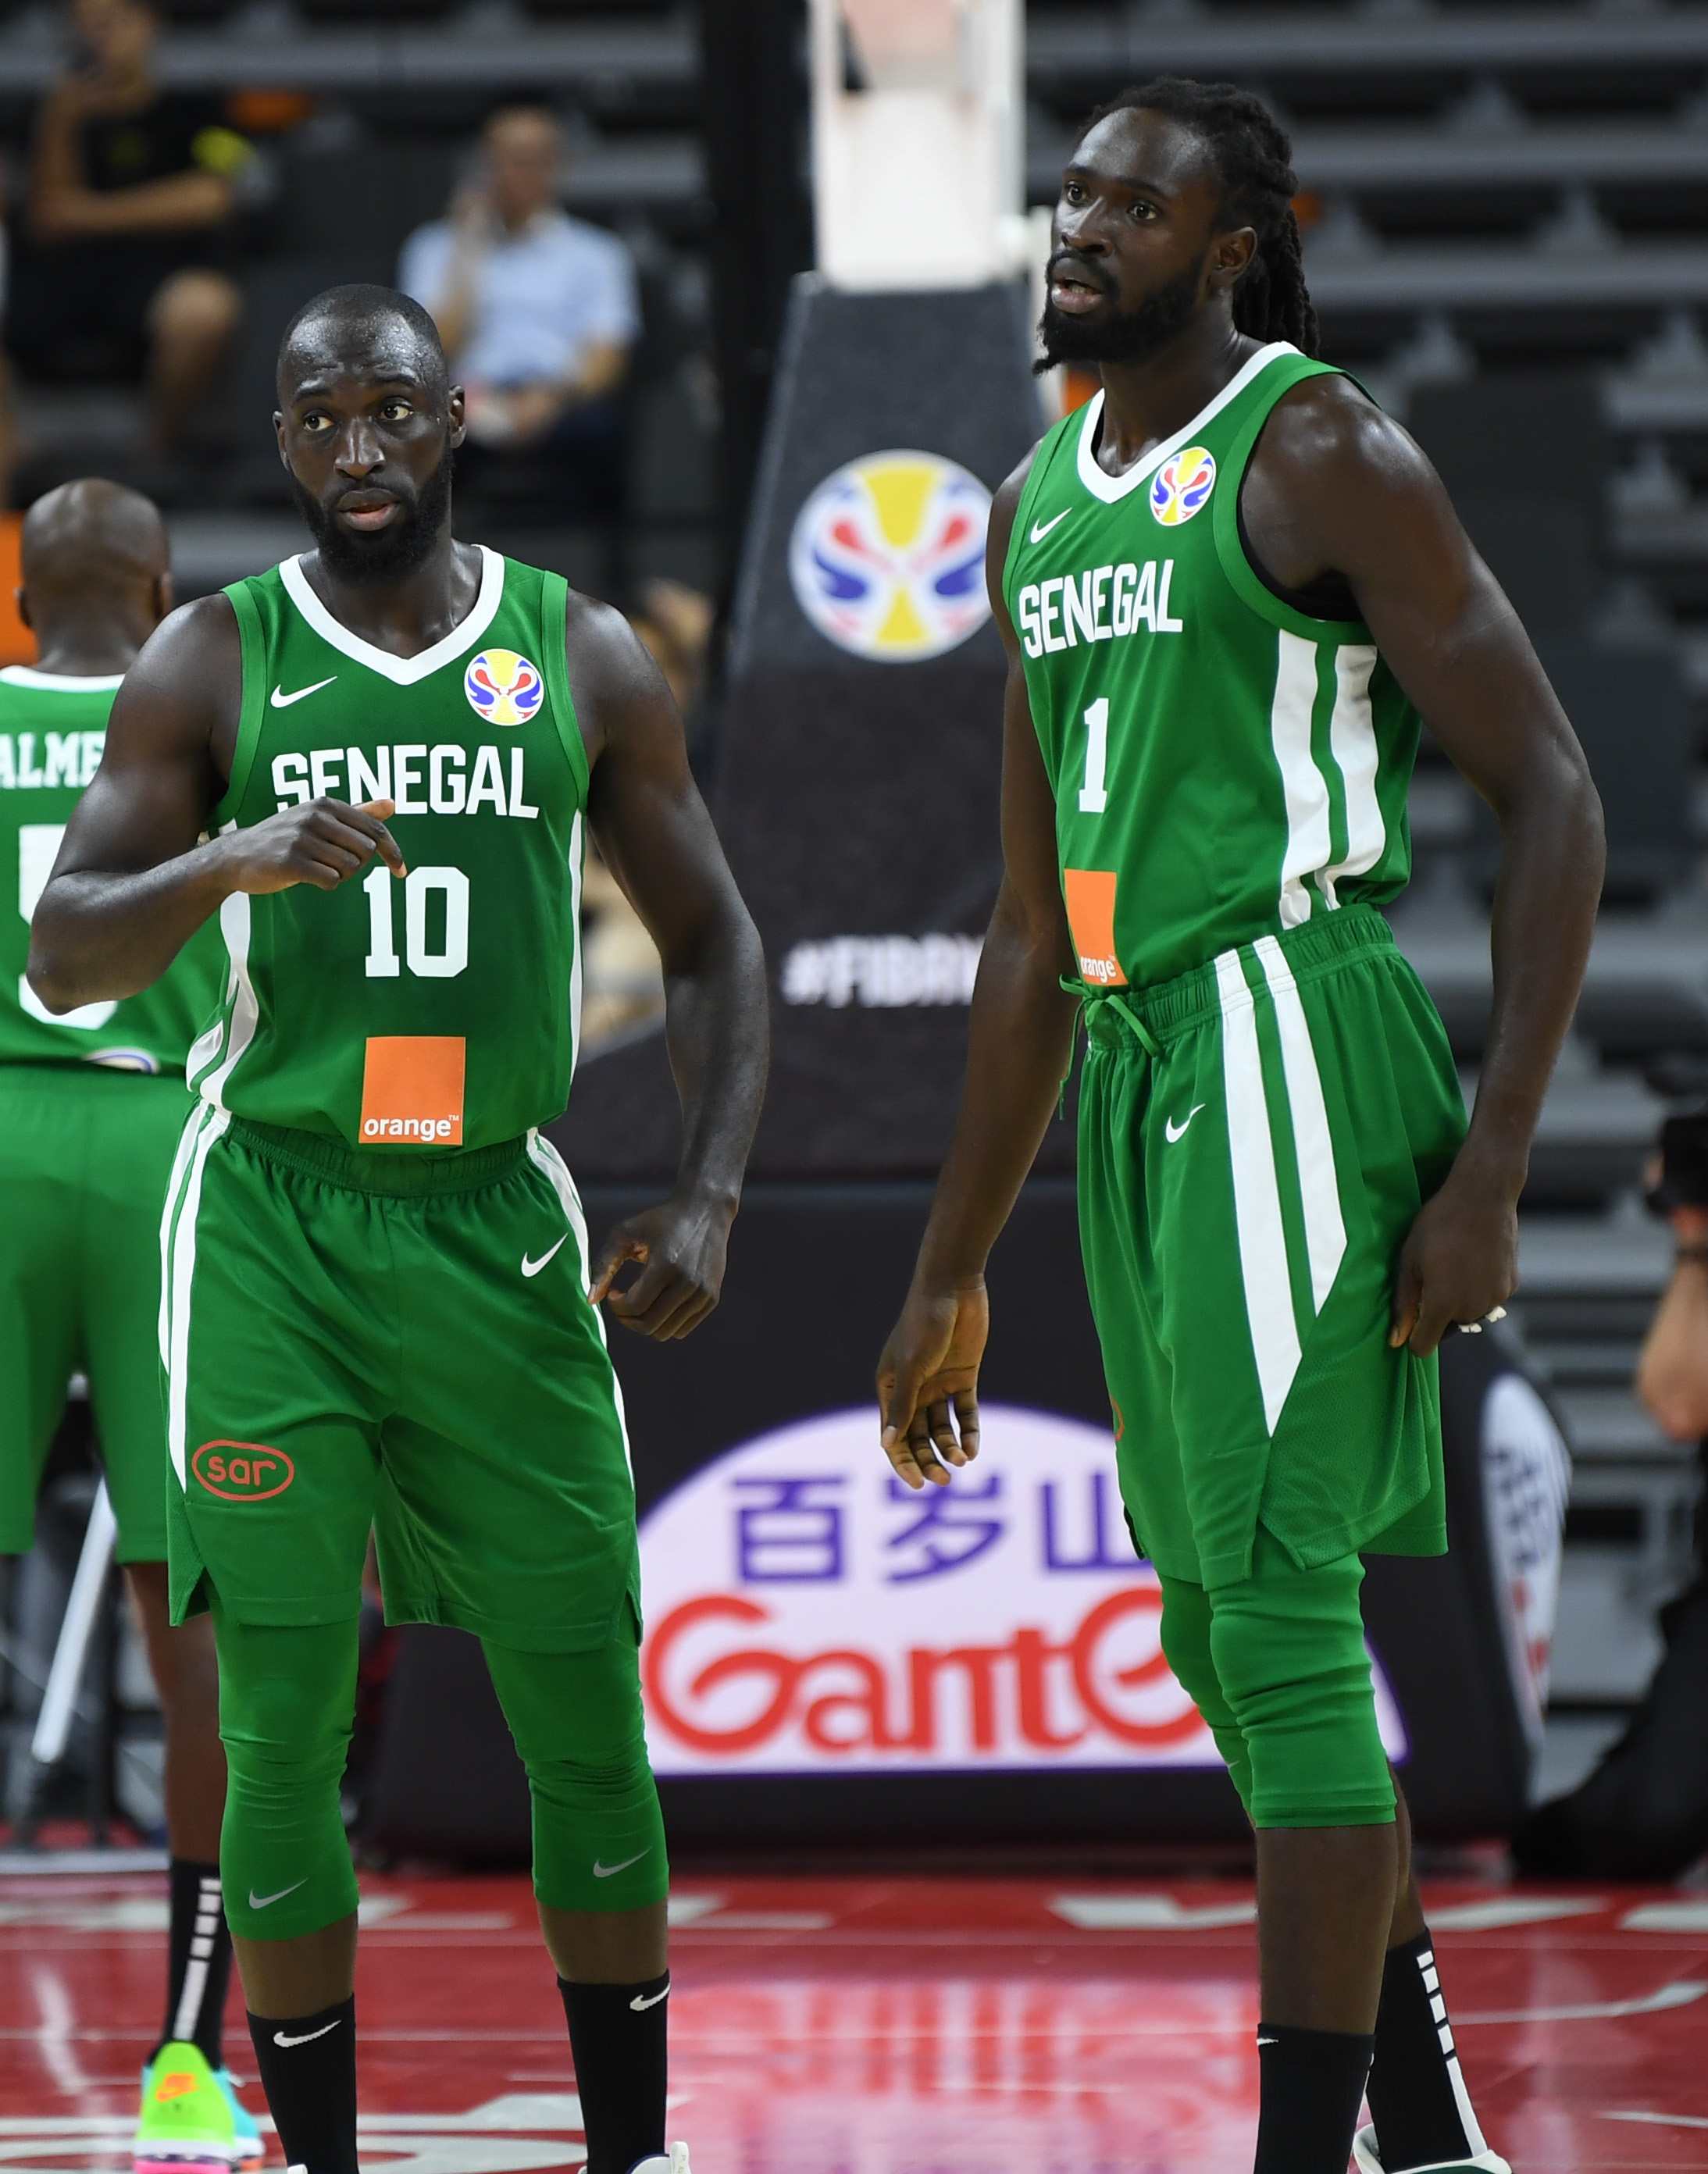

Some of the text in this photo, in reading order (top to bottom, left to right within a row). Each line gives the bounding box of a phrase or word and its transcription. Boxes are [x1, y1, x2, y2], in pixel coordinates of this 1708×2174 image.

[1019, 559, 1182, 658] SENEGAL
[272, 745, 540, 819] SENEGAL
[1079, 698, 1109, 813] 1
[363, 866, 469, 977] 10
[206, 1456, 276, 1487] sar
[729, 1470, 1155, 1585] 百岁山
